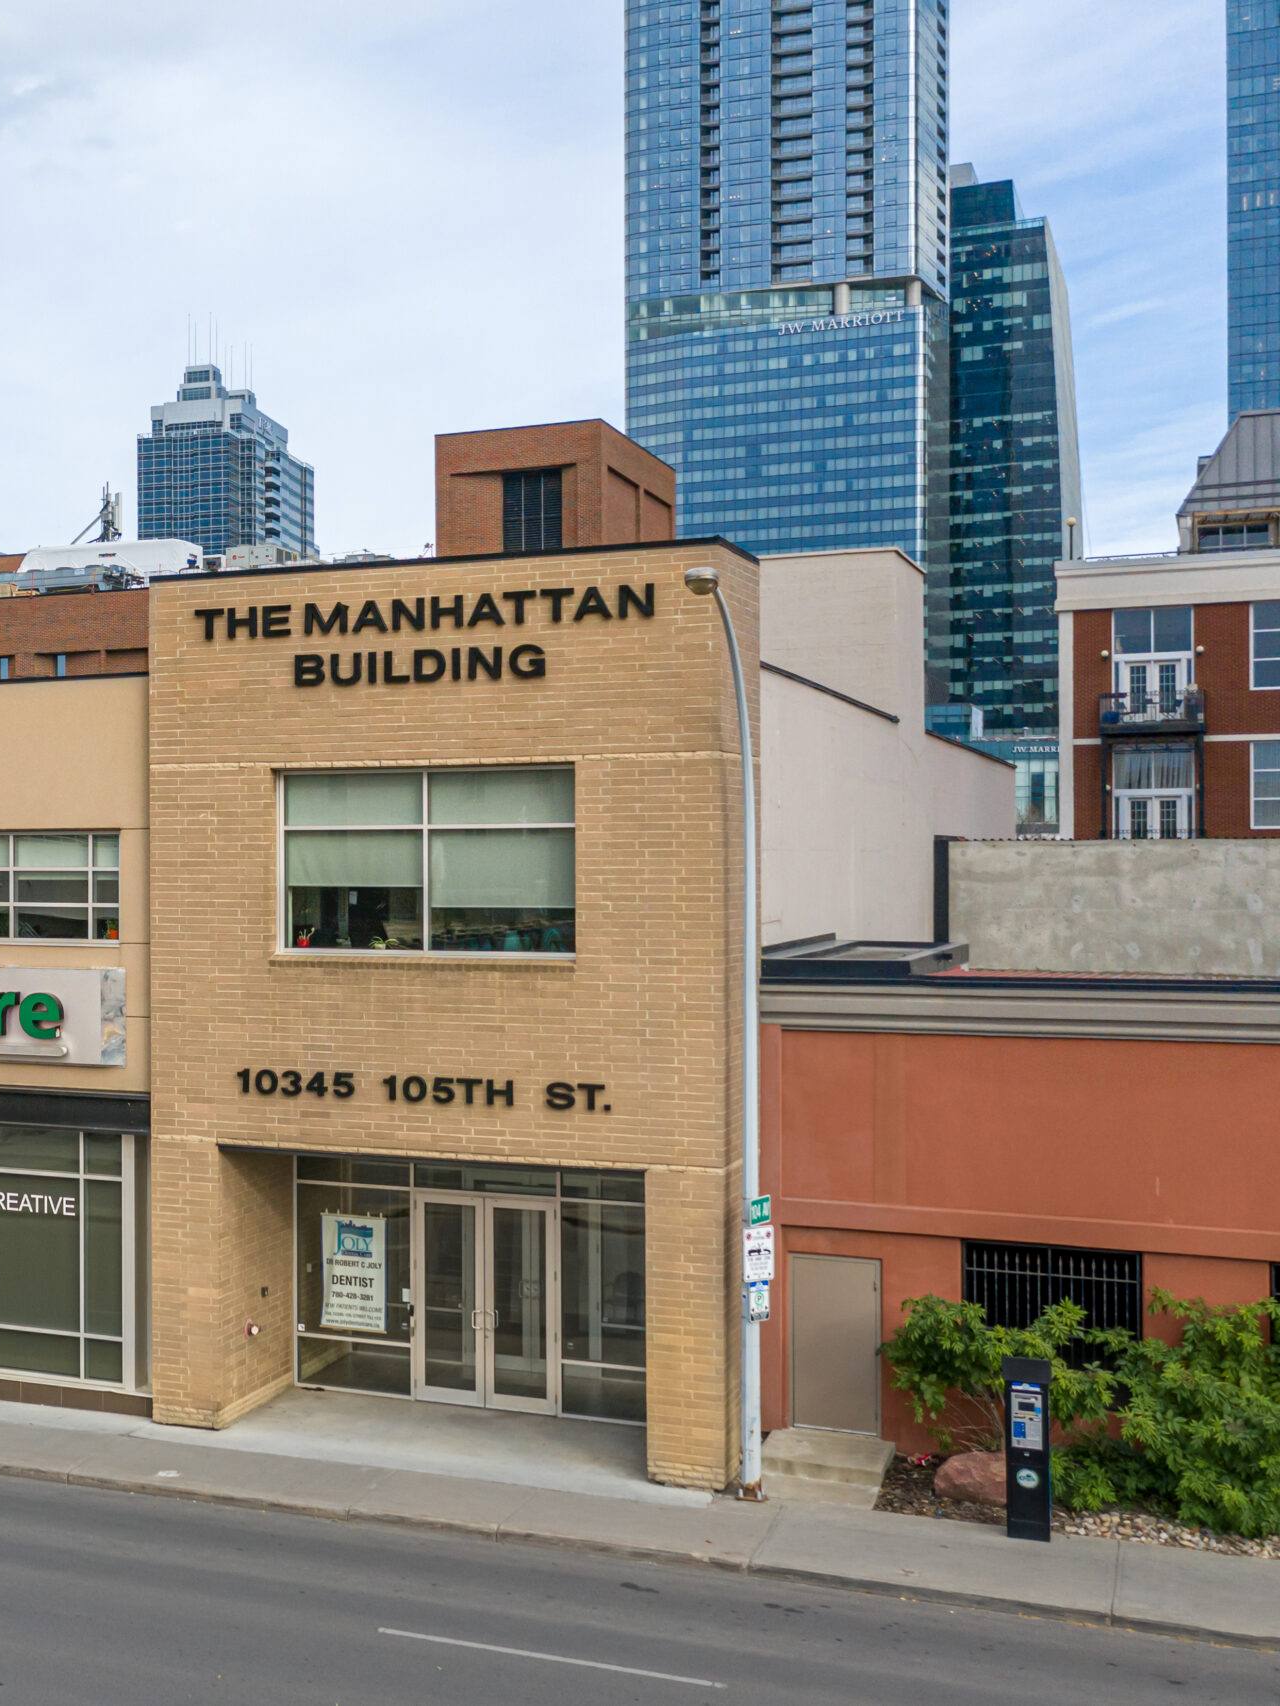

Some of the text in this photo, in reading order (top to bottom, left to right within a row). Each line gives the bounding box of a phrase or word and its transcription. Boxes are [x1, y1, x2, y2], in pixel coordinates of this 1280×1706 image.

[778, 310, 905, 336] JW MARRIOTT
[194, 582, 655, 642] THE MANHATTAN
[294, 643, 546, 687] BUILDING
[1012, 745, 1027, 753] JW
[236, 1068, 612, 1112] 10345 105TH ST.
[334, 1258, 360, 1268] ROBERT
[366, 1262, 383, 1270] JOLY
[331, 1274, 375, 1289] DENTIST
